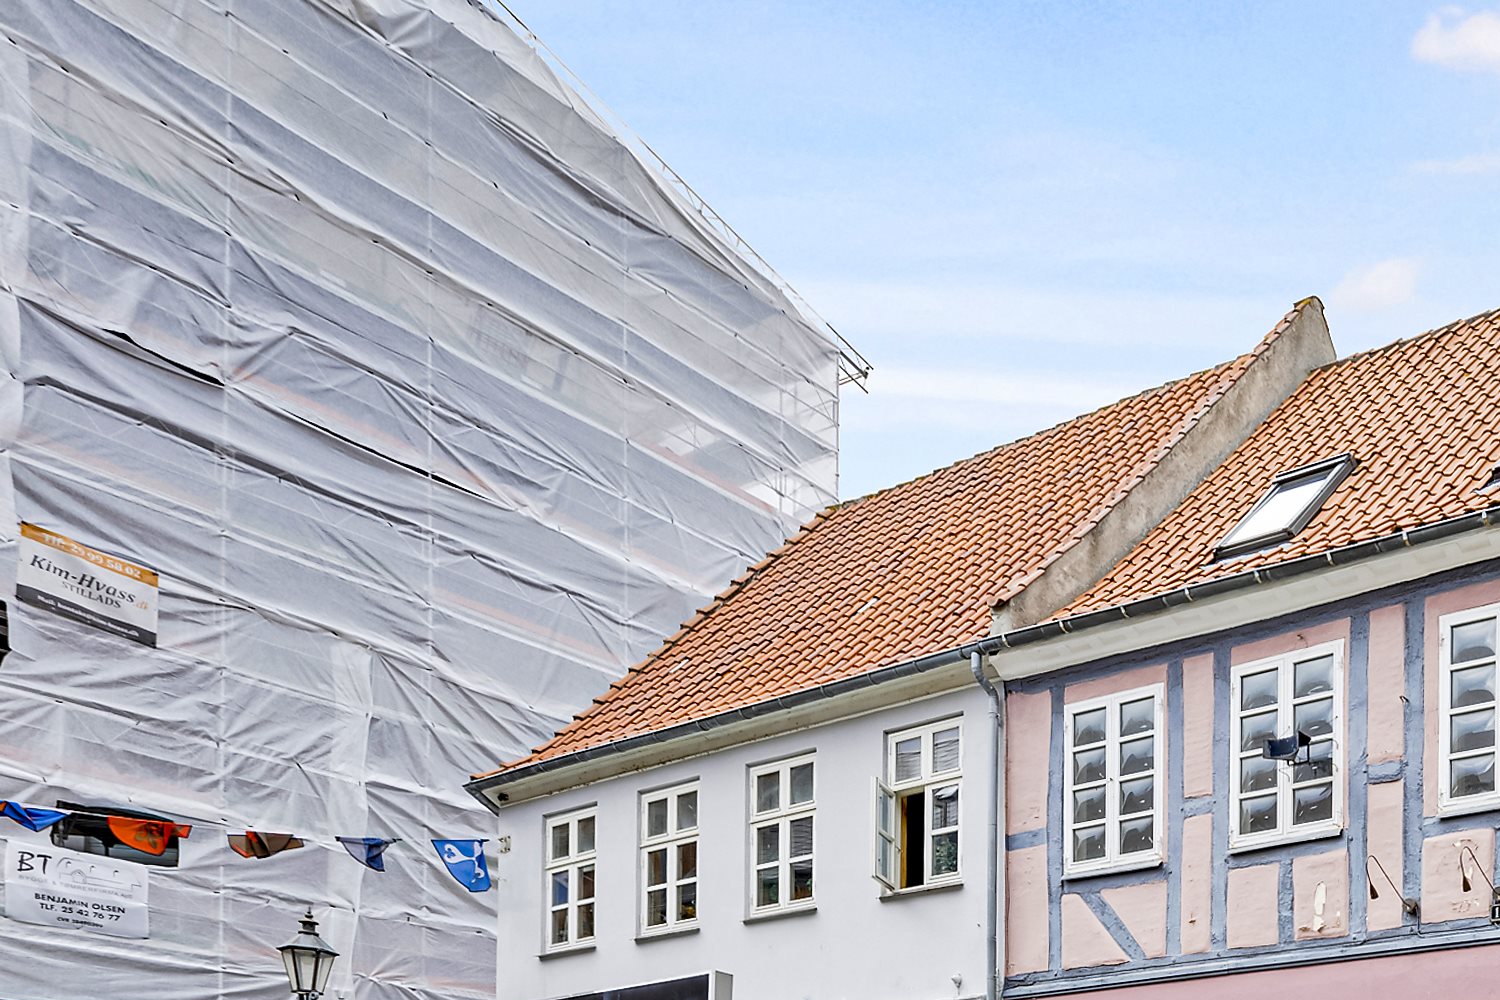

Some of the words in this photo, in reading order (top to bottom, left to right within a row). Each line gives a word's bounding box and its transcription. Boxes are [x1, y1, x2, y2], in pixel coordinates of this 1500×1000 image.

[87, 551, 104, 564] 99
[107, 559, 123, 571] 58
[124, 566, 142, 579] 02
[62, 581, 122, 609] STILLADS
[17, 851, 52, 875] BT
[34, 892, 89, 909] BENJAMIN
[92, 903, 126, 914] OLSEN
[40, 903, 57, 912] TLF.
[61, 906, 74, 914] 25
[77, 908, 89, 917] 42
[93, 911, 105, 920] 76
[108, 914, 121, 922] 77
